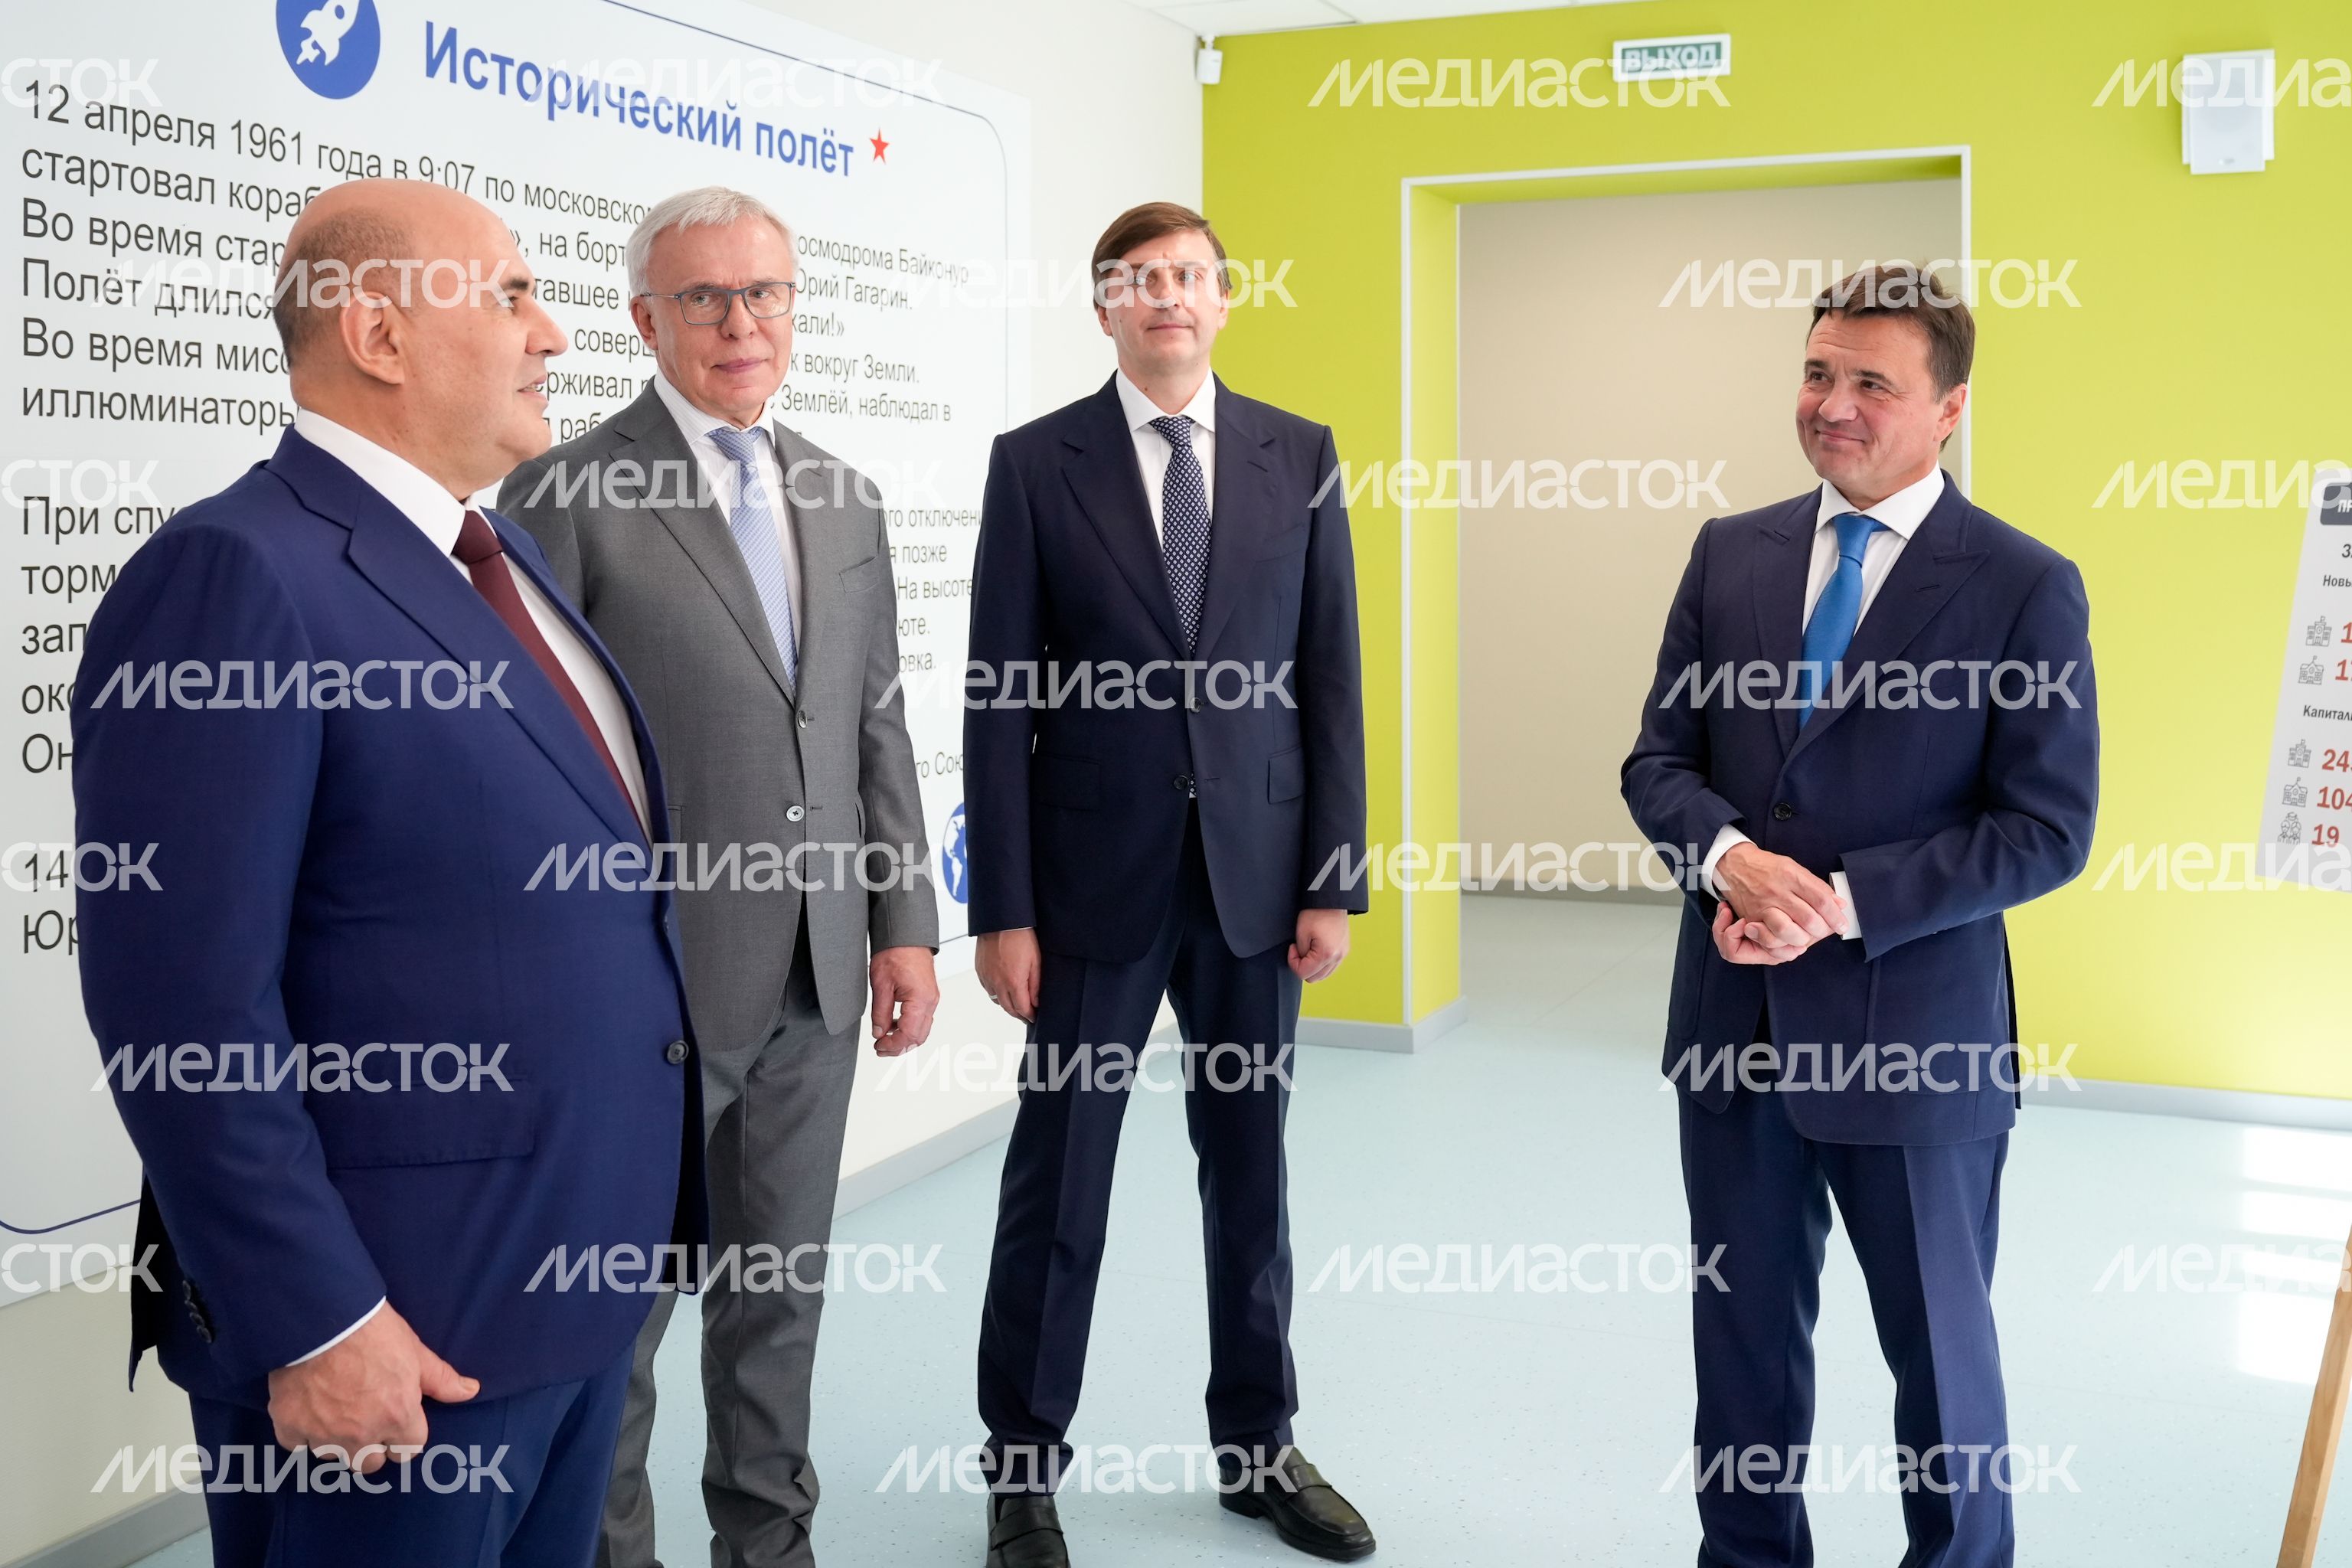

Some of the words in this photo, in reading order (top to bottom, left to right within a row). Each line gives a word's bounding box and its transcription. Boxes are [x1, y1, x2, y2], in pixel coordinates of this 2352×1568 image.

[1624, 44, 1717, 72] ВЫХОД
[426, 20, 741, 152] Исторический
[756, 122, 854, 177] полёт
[26, 80, 70, 124] 12
[84, 100, 215, 149] апреля
[230, 119, 302, 165] 1961
[318, 145, 381, 181] года
[394, 159, 408, 179] в
[485, 177, 514, 203] по
[524, 184, 651, 225] московско
[899, 248, 970, 288] Байконур
[22, 149, 215, 204] стартовал
[540, 233, 567, 259] на
[845, 276, 913, 312] Гагарин.
[23, 197, 74, 242] Во
[89, 217, 202, 257] время
[24, 257, 142, 306] Полёт
[805, 354, 858, 384] вокруг
[864, 354, 920, 384] Земли.
[23, 316, 74, 359] Во
[89, 332, 202, 373] время
[781, 384, 853, 418] Землёй,
[859, 393, 938, 426] наблюдал
[943, 404, 952, 422] в
[24, 495, 99, 544] При
[902, 544, 948, 564] позже
[897, 576, 918, 600] На
[923, 577, 972, 599] высоте
[2335, 659, 2352, 681] 1
[2321, 749, 2352, 773] 24
[2311, 824, 2340, 848] 19
[25, 850, 69, 893] 14
